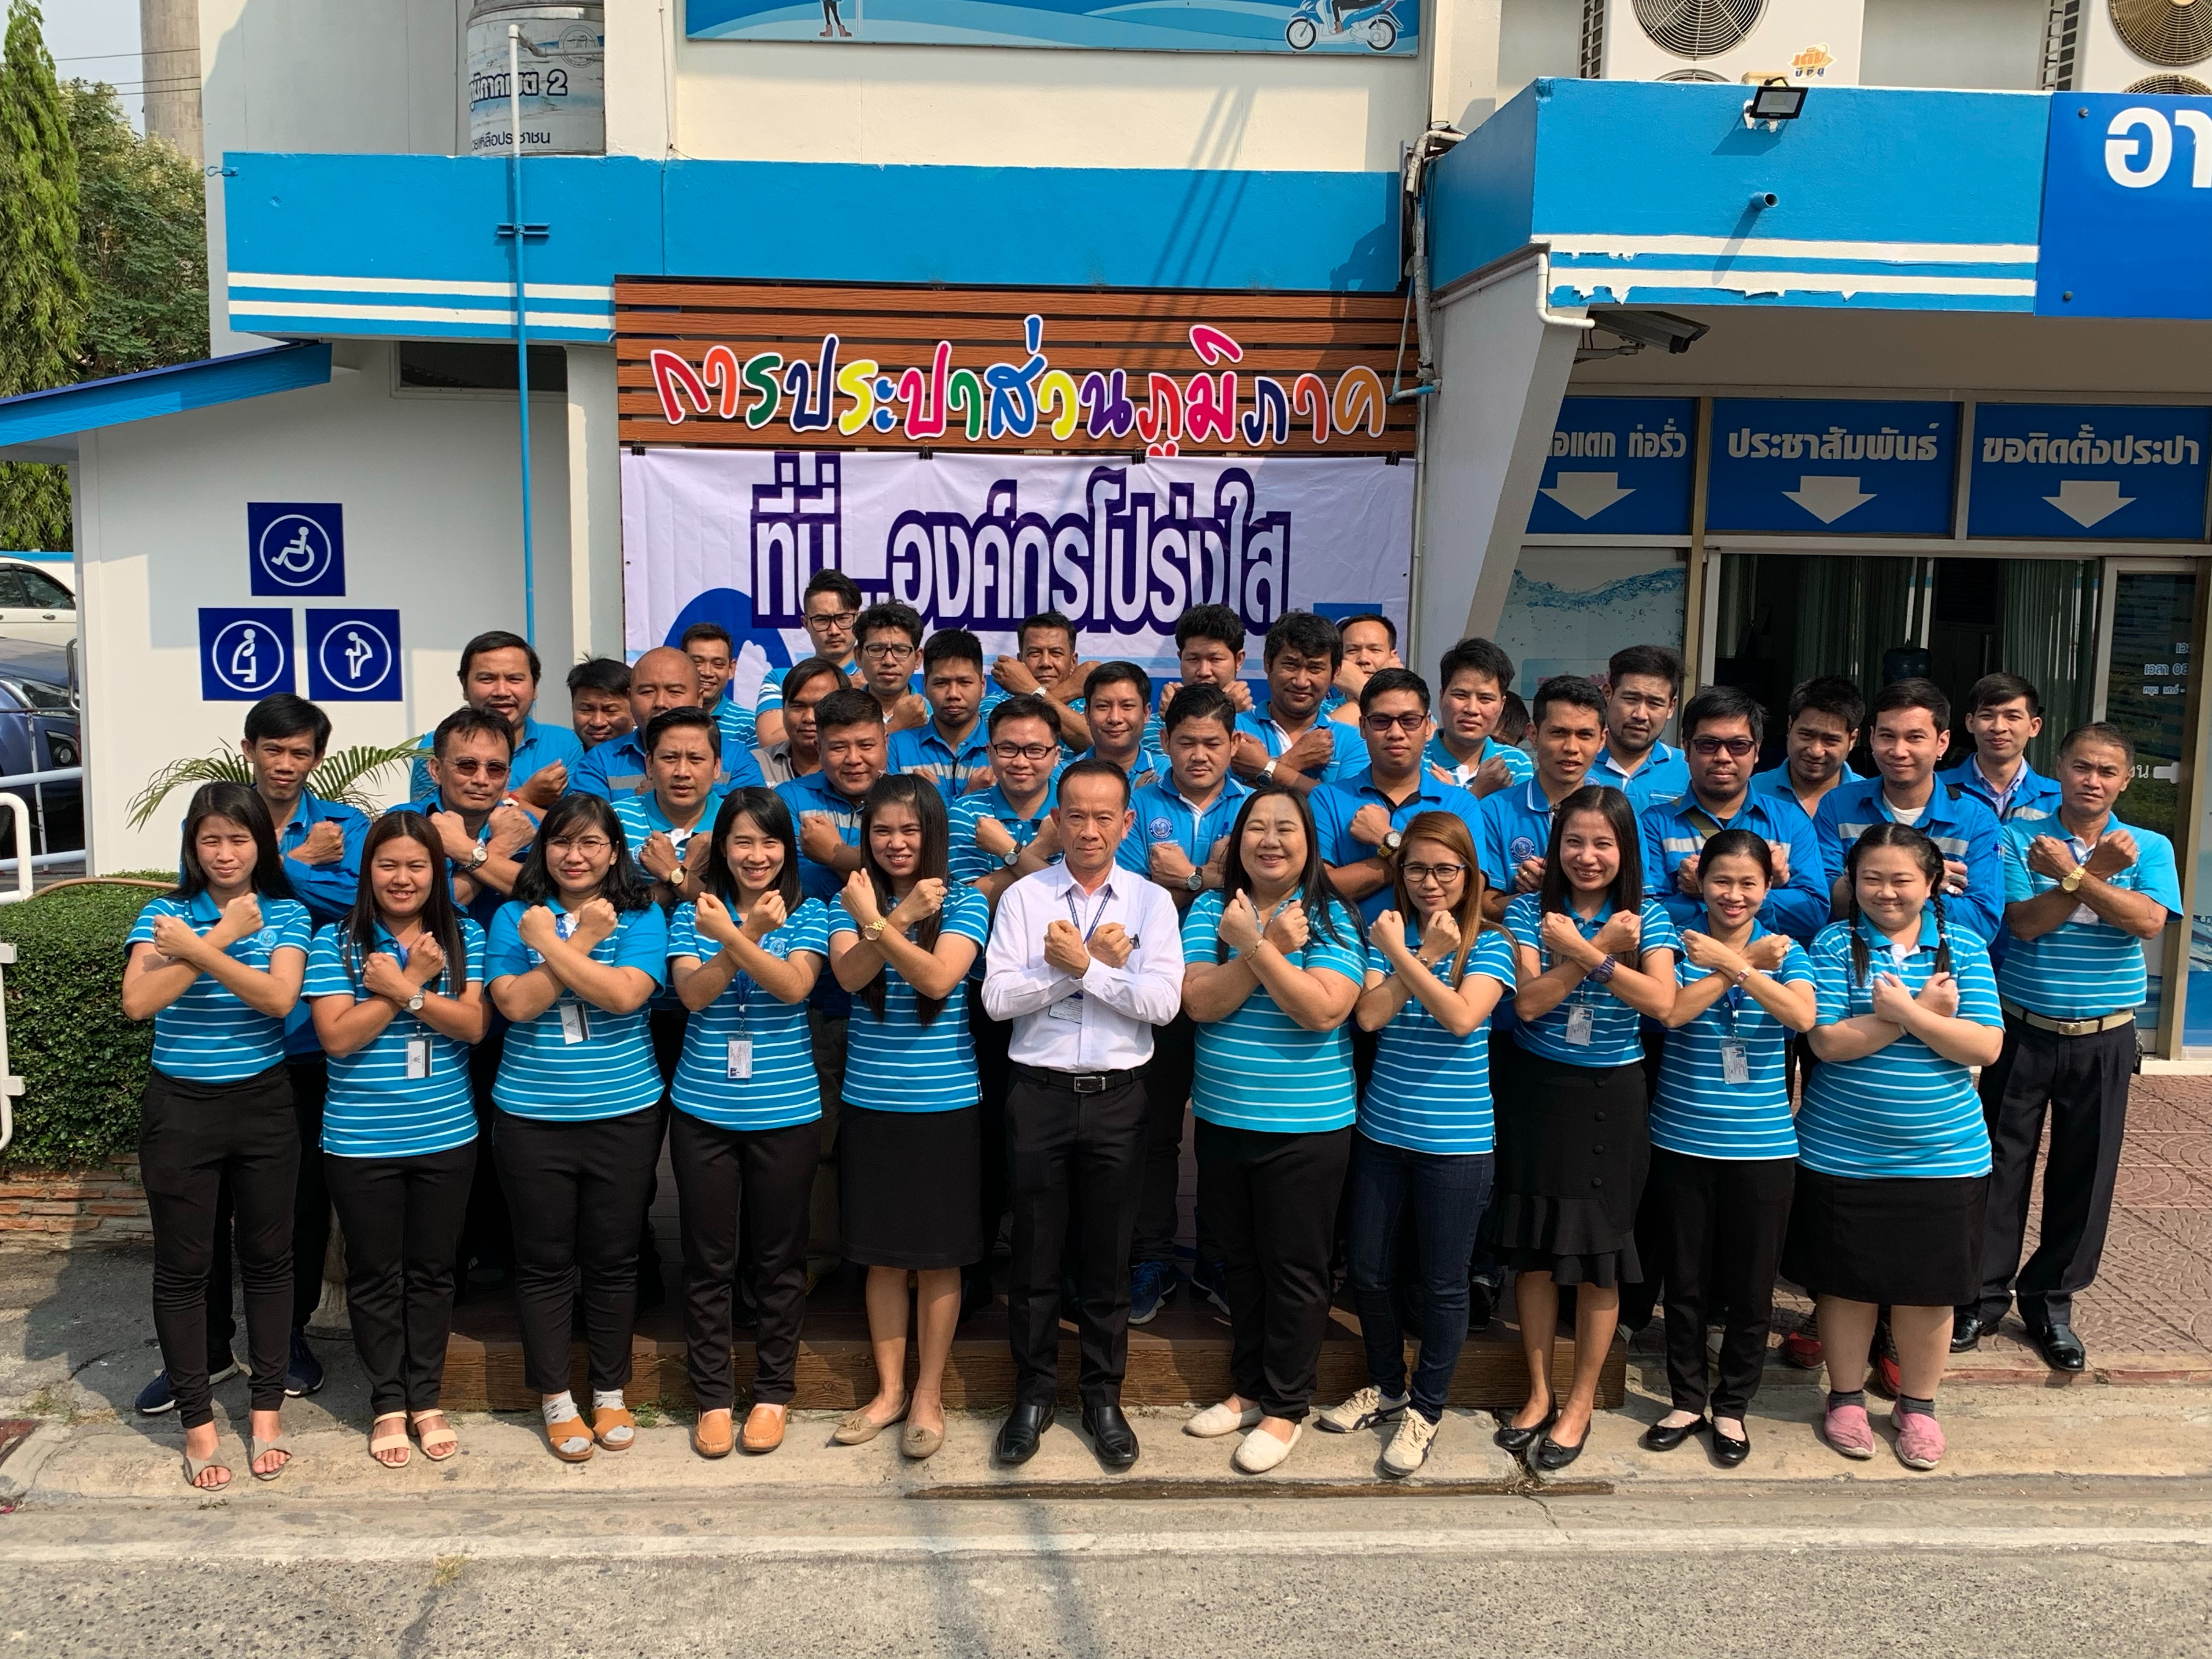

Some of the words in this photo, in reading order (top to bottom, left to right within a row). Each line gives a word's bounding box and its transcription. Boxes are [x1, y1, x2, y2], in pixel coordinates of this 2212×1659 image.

[546, 68, 568, 96] 2
[651, 314, 1386, 456] การประปาส่วนภูมิภาค
[1547, 431, 1616, 458] อแตก
[1628, 418, 1687, 458] ท่อรั่ว
[1728, 422, 1940, 461] ประชาสัมพันธ์
[1982, 424, 2199, 465] ขอติดตั้งประปา
[2144, 663, 2169, 676] เวลา
